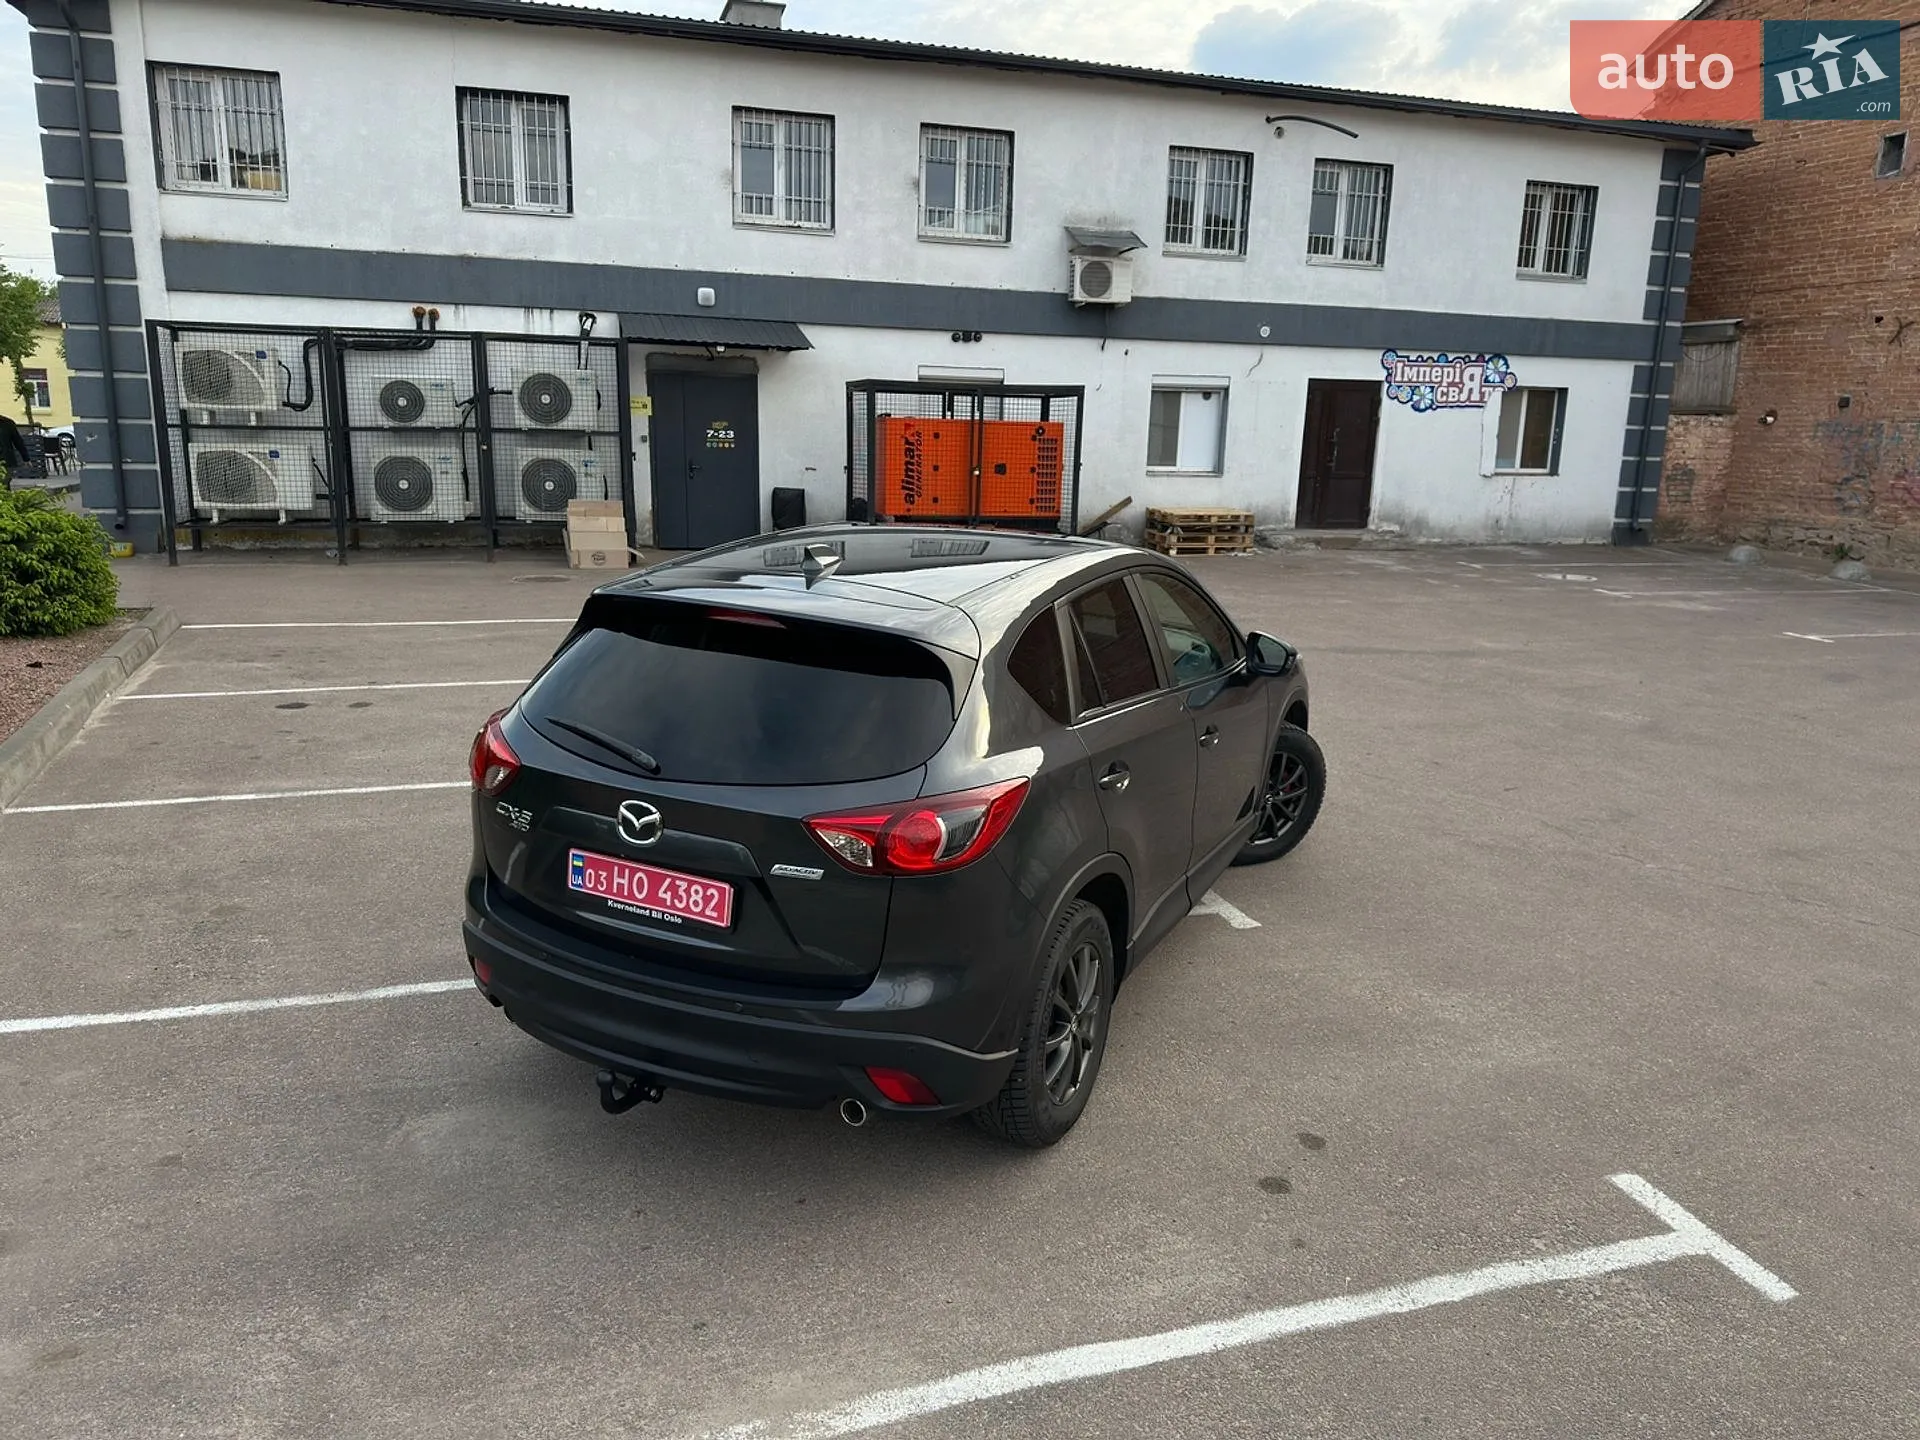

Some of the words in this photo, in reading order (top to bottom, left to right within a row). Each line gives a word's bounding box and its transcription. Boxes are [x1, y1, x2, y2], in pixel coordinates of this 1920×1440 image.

[706, 429, 735, 439] 7-23
[915, 431, 923, 498] GENERATOR
[572, 874, 583, 887] UA
[585, 868, 607, 891] 03
[613, 865, 648, 899] HO
[658, 878, 720, 918] 4382
[607, 899, 651, 916] Kverneland
[652, 910, 663, 920] Bil
[664, 913, 682, 924] Oslo
